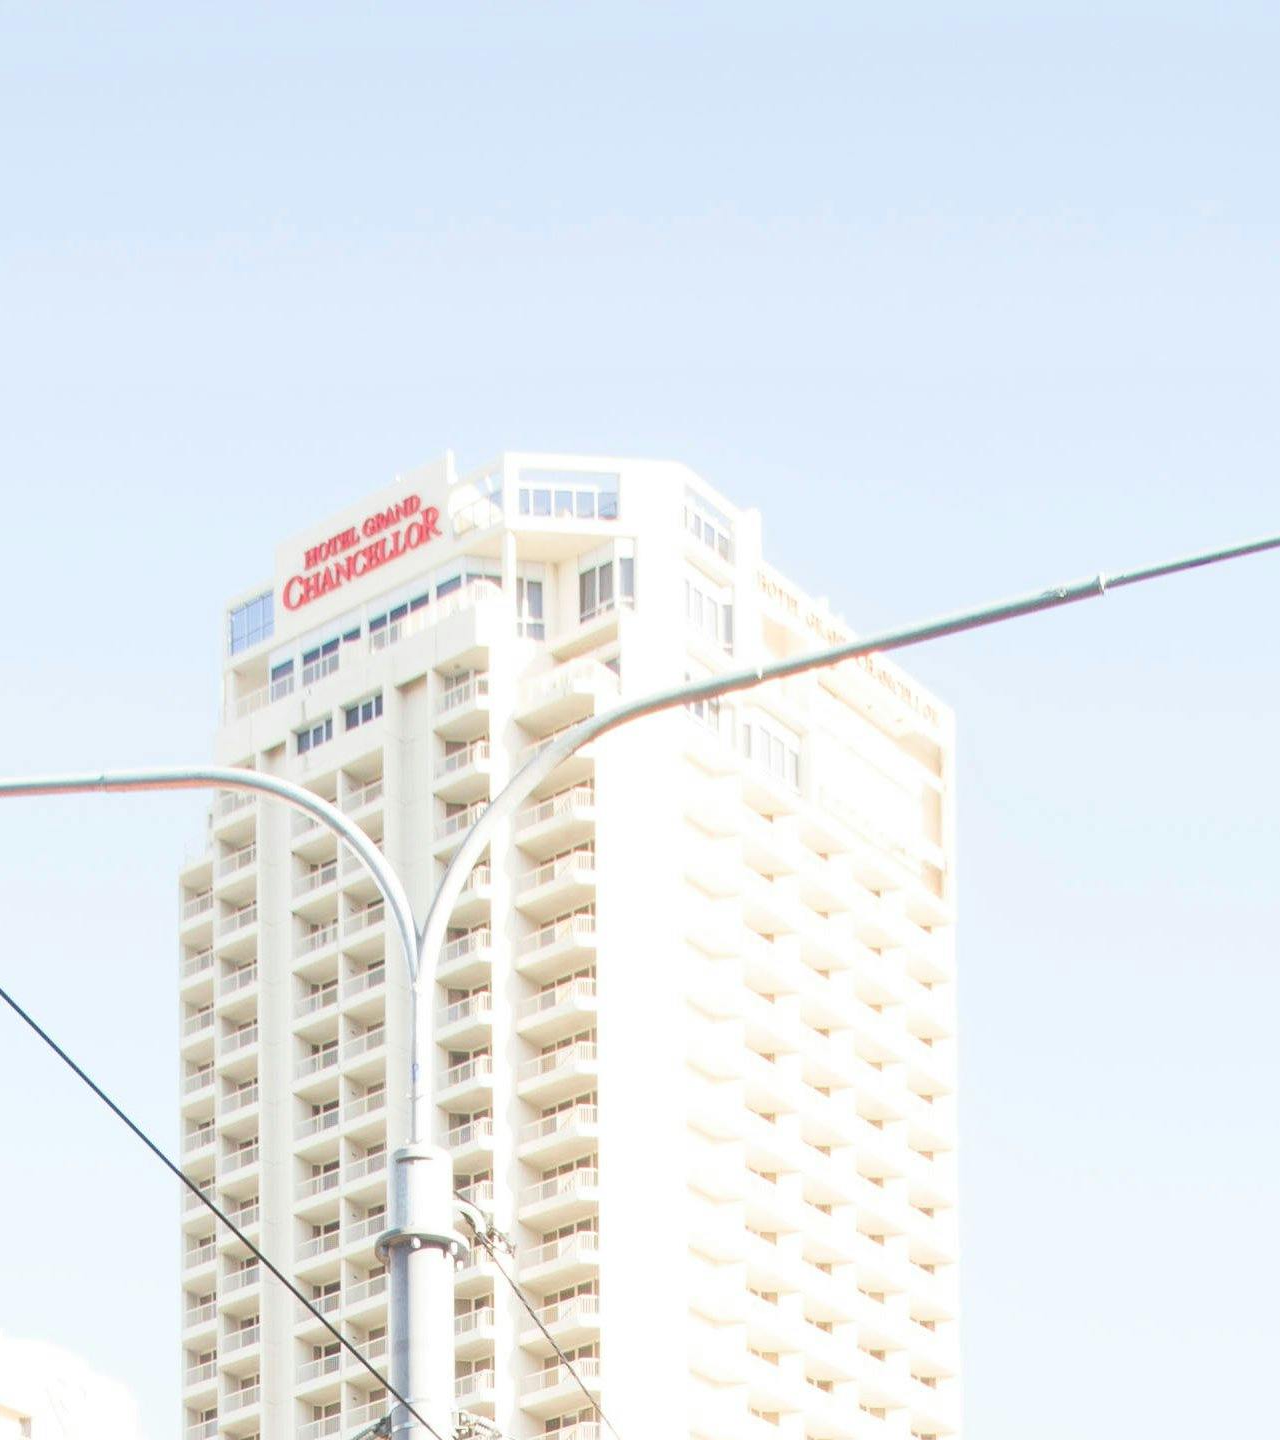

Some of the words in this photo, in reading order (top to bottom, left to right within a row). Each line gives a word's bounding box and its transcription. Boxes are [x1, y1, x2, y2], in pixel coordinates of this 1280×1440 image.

[283, 505, 443, 612] CHANCELLOR
[304, 526, 360, 570] HOTEL
[362, 494, 421, 537] GRAND
